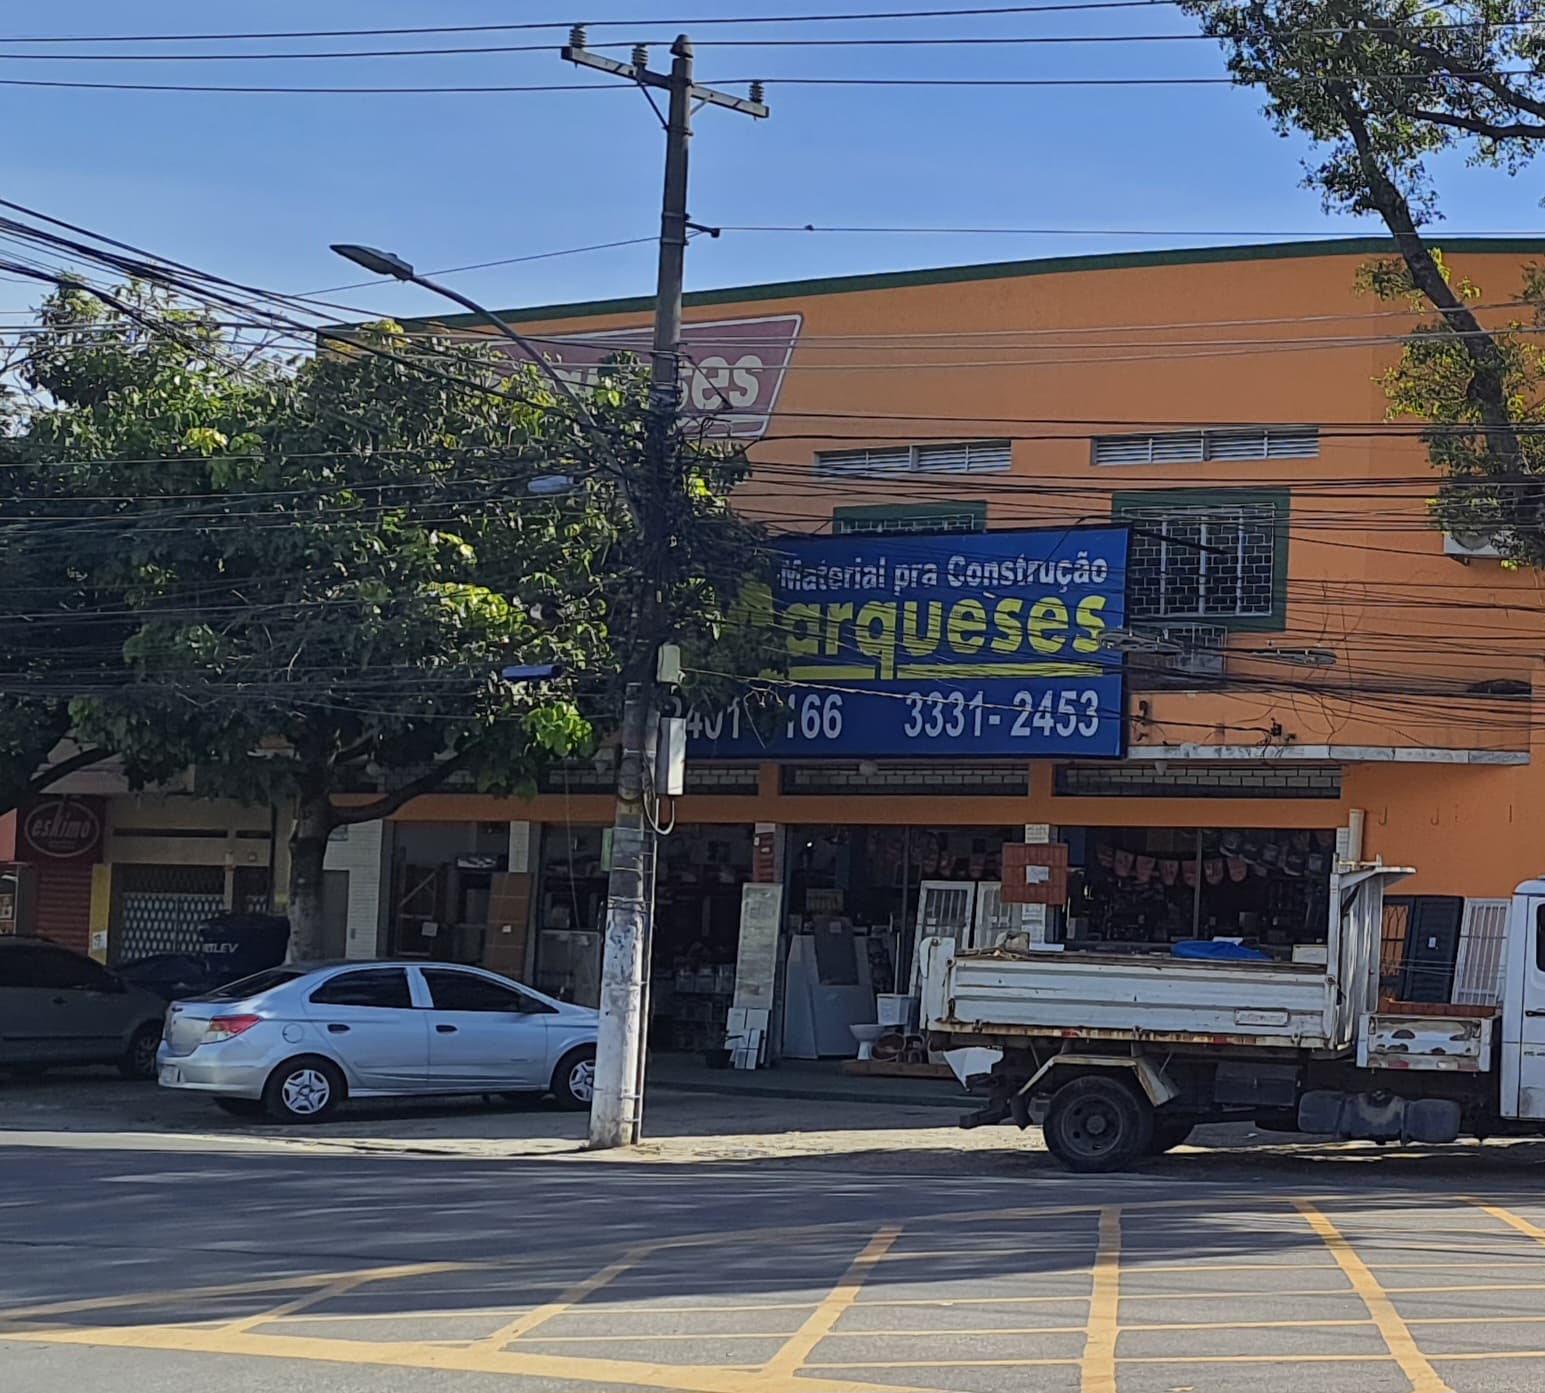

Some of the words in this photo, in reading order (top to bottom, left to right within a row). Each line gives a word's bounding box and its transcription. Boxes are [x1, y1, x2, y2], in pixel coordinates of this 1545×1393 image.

[779, 556, 886, 592] Material
[894, 562, 938, 596] pra
[947, 551, 1109, 593] Construção
[32, 804, 91, 839] eskimo
